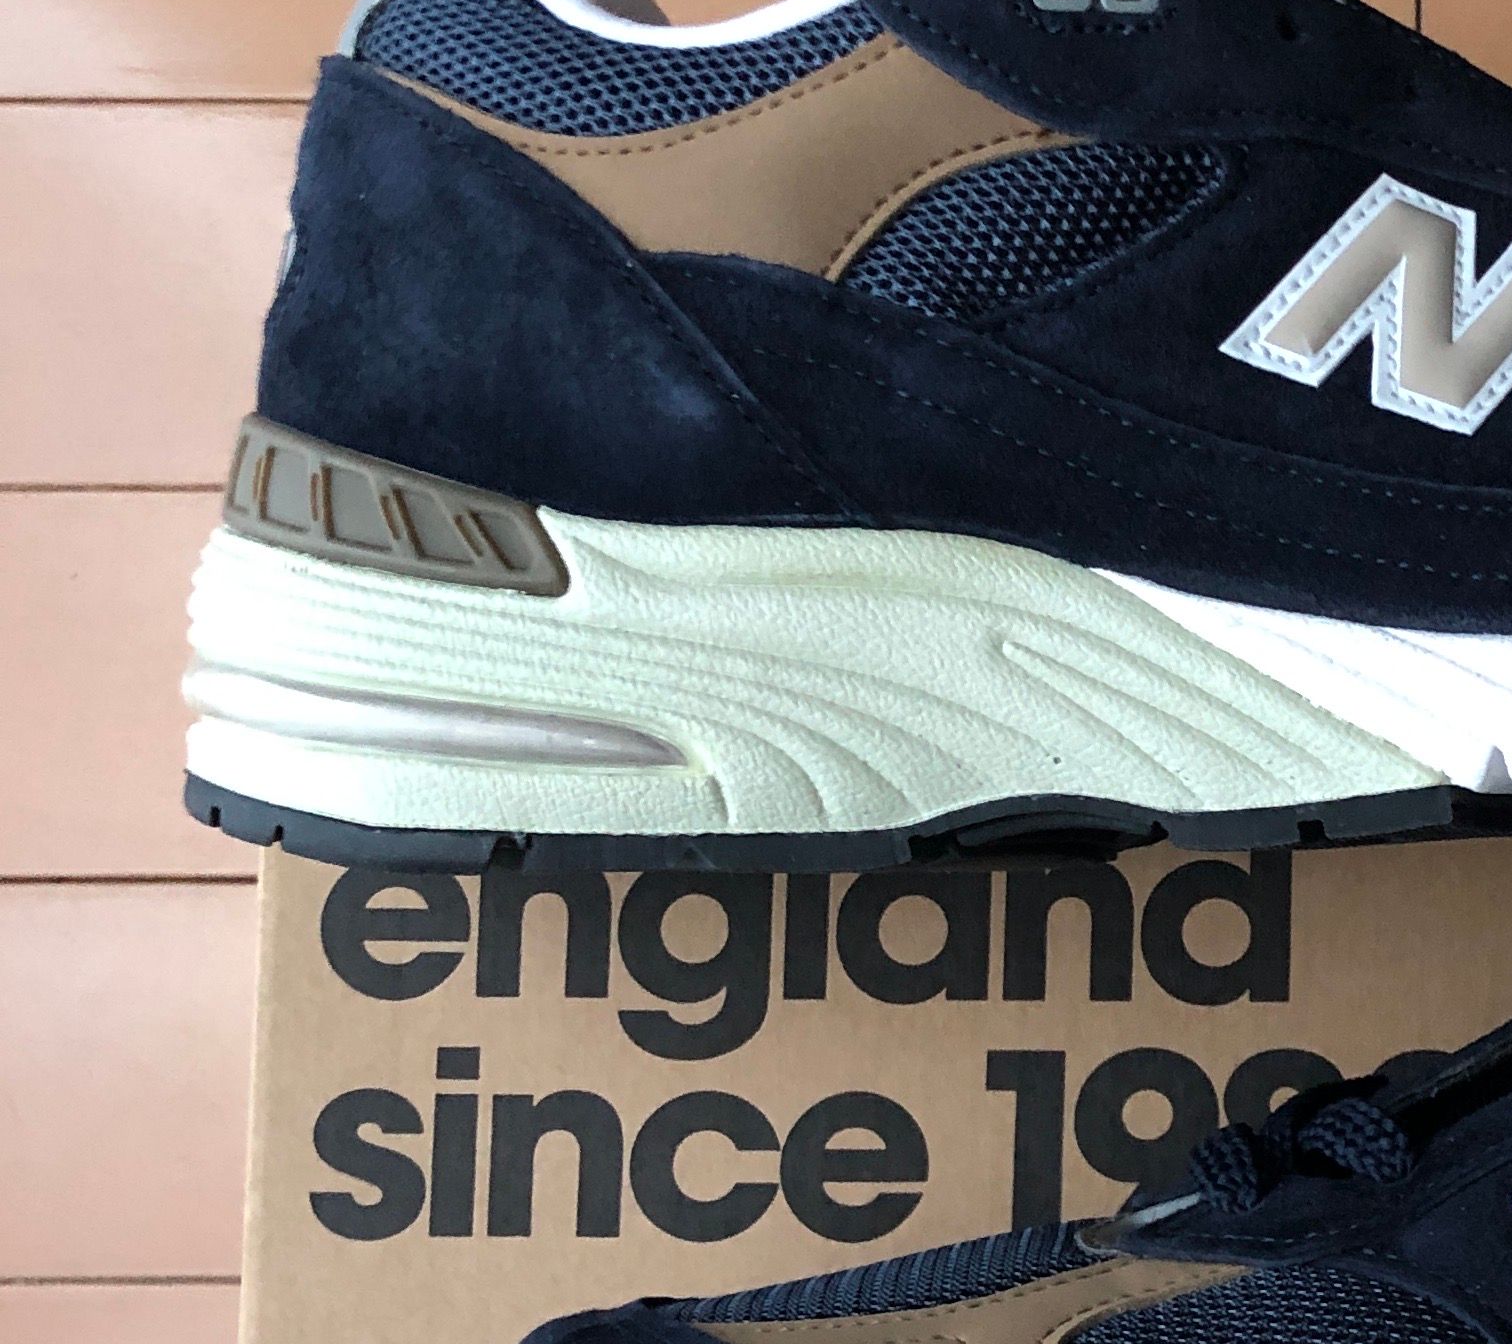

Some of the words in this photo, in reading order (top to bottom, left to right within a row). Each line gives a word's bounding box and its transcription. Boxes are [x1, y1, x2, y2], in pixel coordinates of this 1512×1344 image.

[320, 849, 1292, 1060] england
[310, 1046, 929, 1242] since
[986, 1046, 1456, 1233] 19
